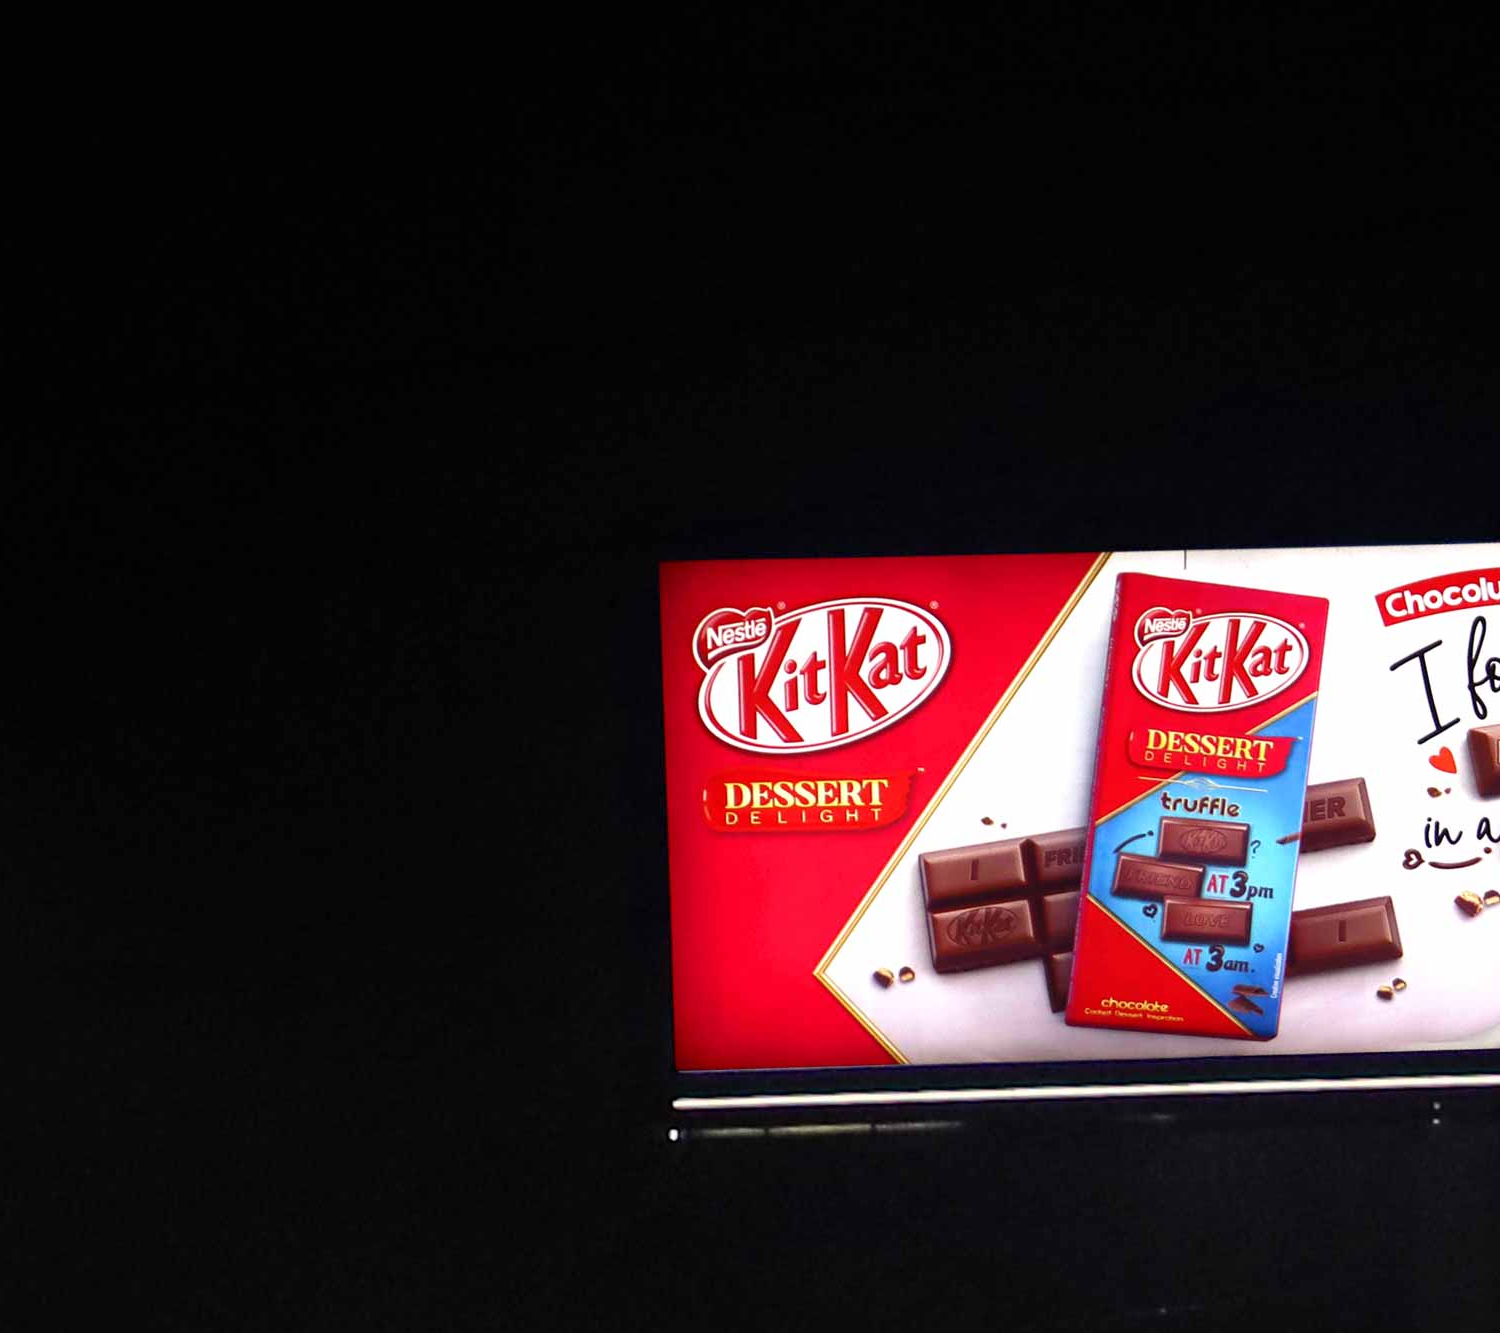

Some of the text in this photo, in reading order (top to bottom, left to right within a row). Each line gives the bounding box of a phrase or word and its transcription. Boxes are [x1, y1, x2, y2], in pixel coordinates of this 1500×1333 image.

[737, 607, 927, 743] KitKat
[1157, 618, 1293, 705] KitKat
[1390, 639, 1461, 745] I
[1145, 729, 1274, 762] DESSERT
[1144, 750, 1268, 773] DELIGHT
[723, 778, 889, 810] DESSERT
[1160, 792, 1240, 817] truffle
[725, 808, 882, 826] DELIGHT
[1424, 817, 1463, 849] in
[1206, 874, 1227, 894] AT
[1183, 949, 1202, 965] AT
[1101, 997, 1169, 1013] chocolate
